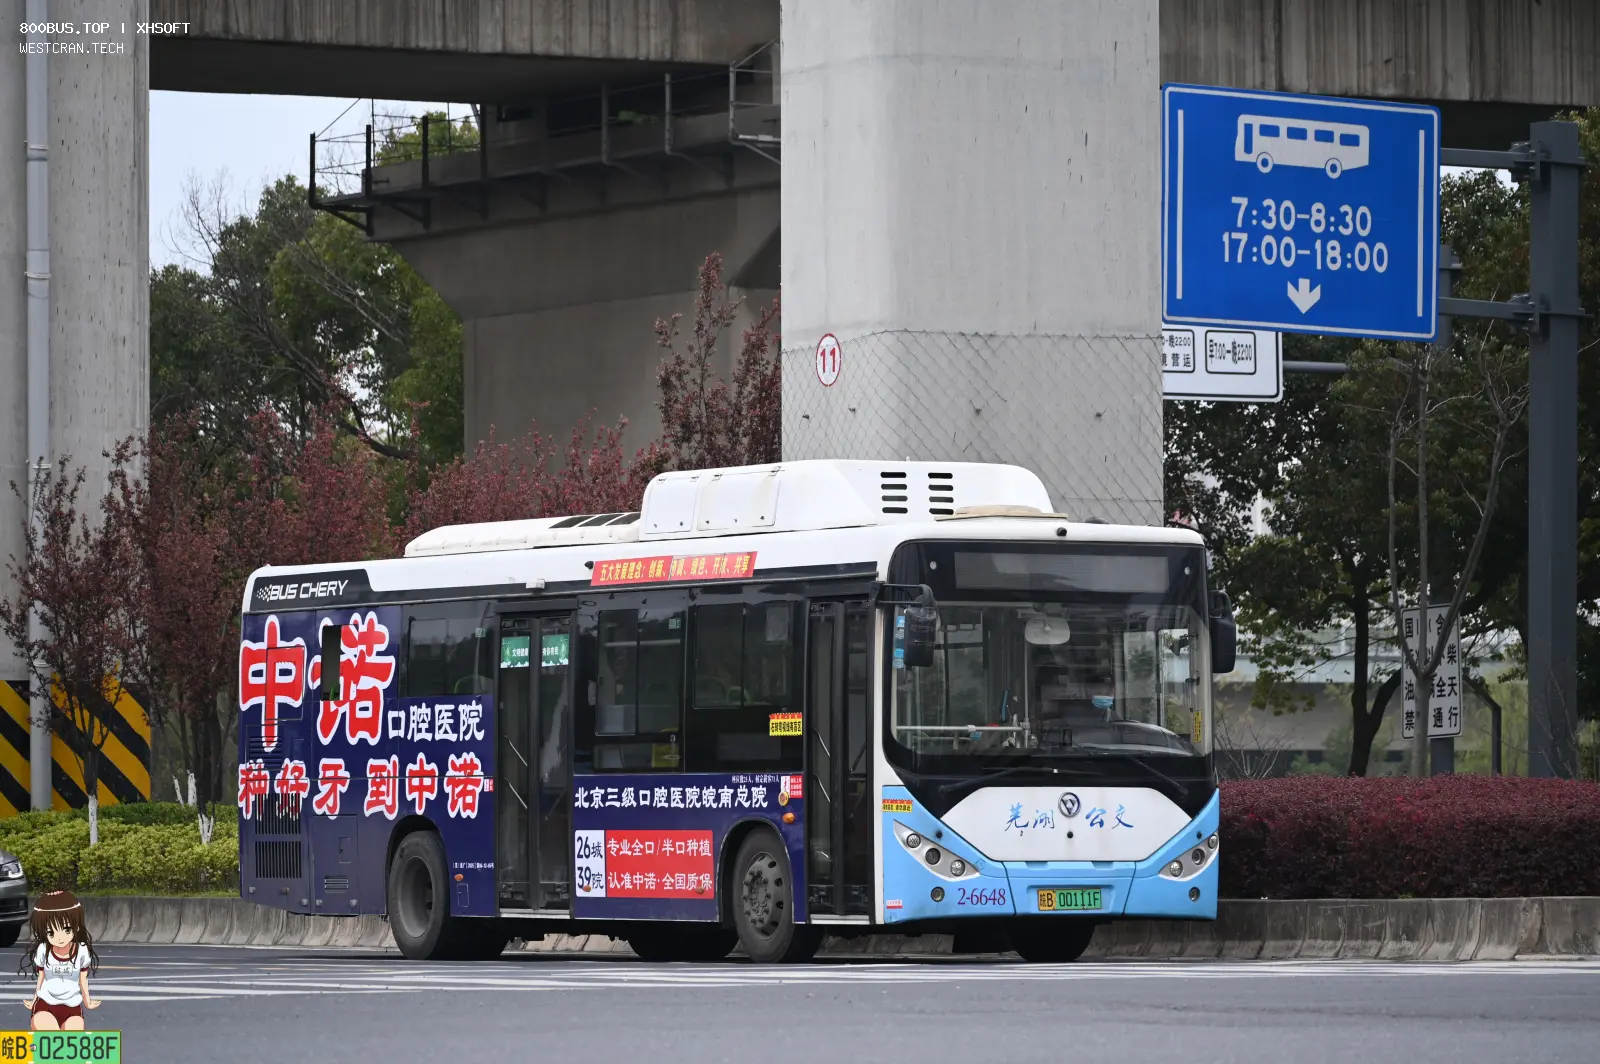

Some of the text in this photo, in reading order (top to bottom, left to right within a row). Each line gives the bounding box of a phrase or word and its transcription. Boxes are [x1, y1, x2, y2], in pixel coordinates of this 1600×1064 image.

[1231, 196, 1372, 237] 7:30-8:30
[1222, 231, 1389, 273] 17:00-18:00
[820, 347, 836, 373] 11
[269, 579, 349, 601] BUS CHERY
[387, 699, 485, 743] 口腔医院
[1404, 706, 1459, 732] 禁通行
[574, 784, 768, 809] 北京三级口腔医院皖南总院
[1004, 802, 1134, 832] 芜湖 公交
[576, 836, 604, 860] 26城
[576, 866, 605, 890] 39院
[957, 887, 1006, 906] 2-6648
[1059, 891, 1100, 907] 00111F
